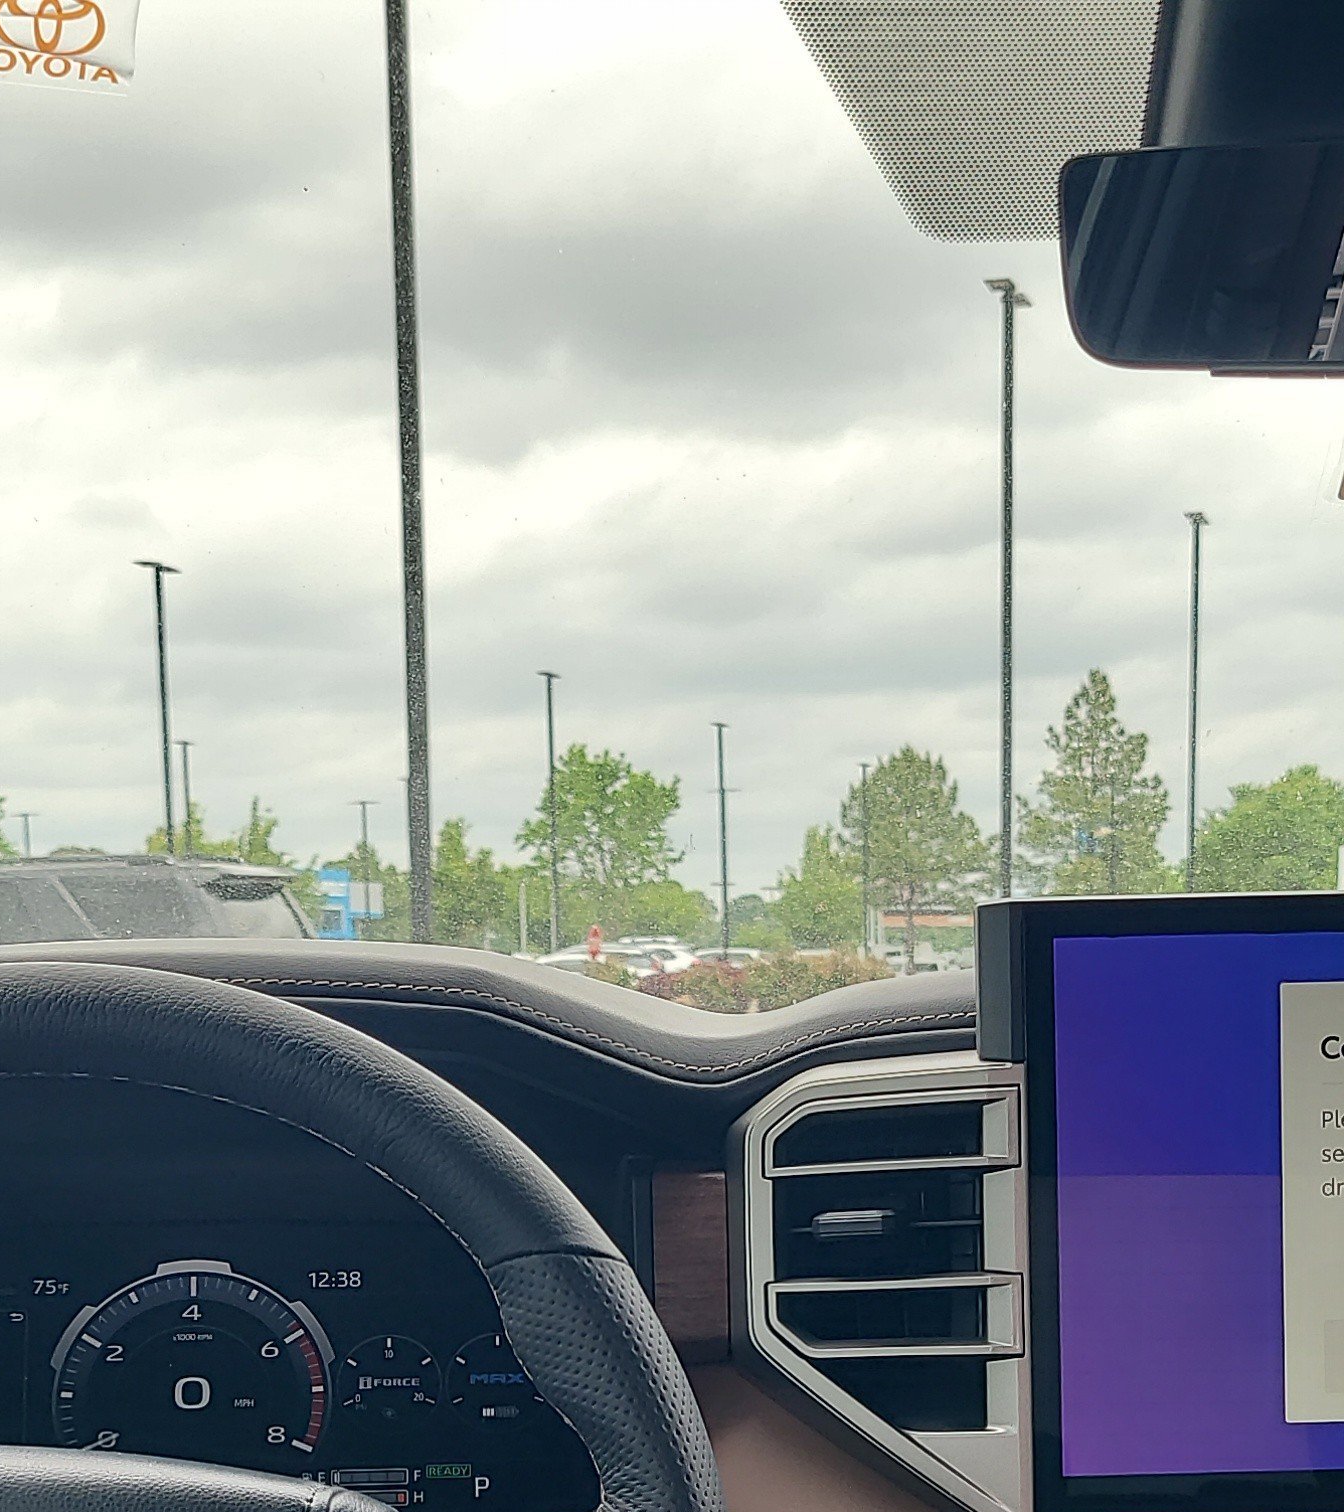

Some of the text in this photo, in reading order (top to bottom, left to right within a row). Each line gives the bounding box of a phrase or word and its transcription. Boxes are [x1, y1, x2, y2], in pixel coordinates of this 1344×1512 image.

[308, 1271, 362, 1288] 12:38
[181, 1305, 202, 1321] 4
[106, 1345, 124, 1362] 2
[261, 1341, 279, 1357] 6
[384, 1350, 394, 1359] 10
[470, 1373, 524, 1385] MAX
[174, 1377, 211, 1409] 0
[413, 1392, 424, 1401] 20
[234, 1399, 255, 1407] MPH
[267, 1426, 285, 1443] 8
[414, 1470, 422, 1481] F
[428, 1465, 468, 1476] READY
[474, 1477, 490, 1498] P
[414, 1491, 424, 1503] H
